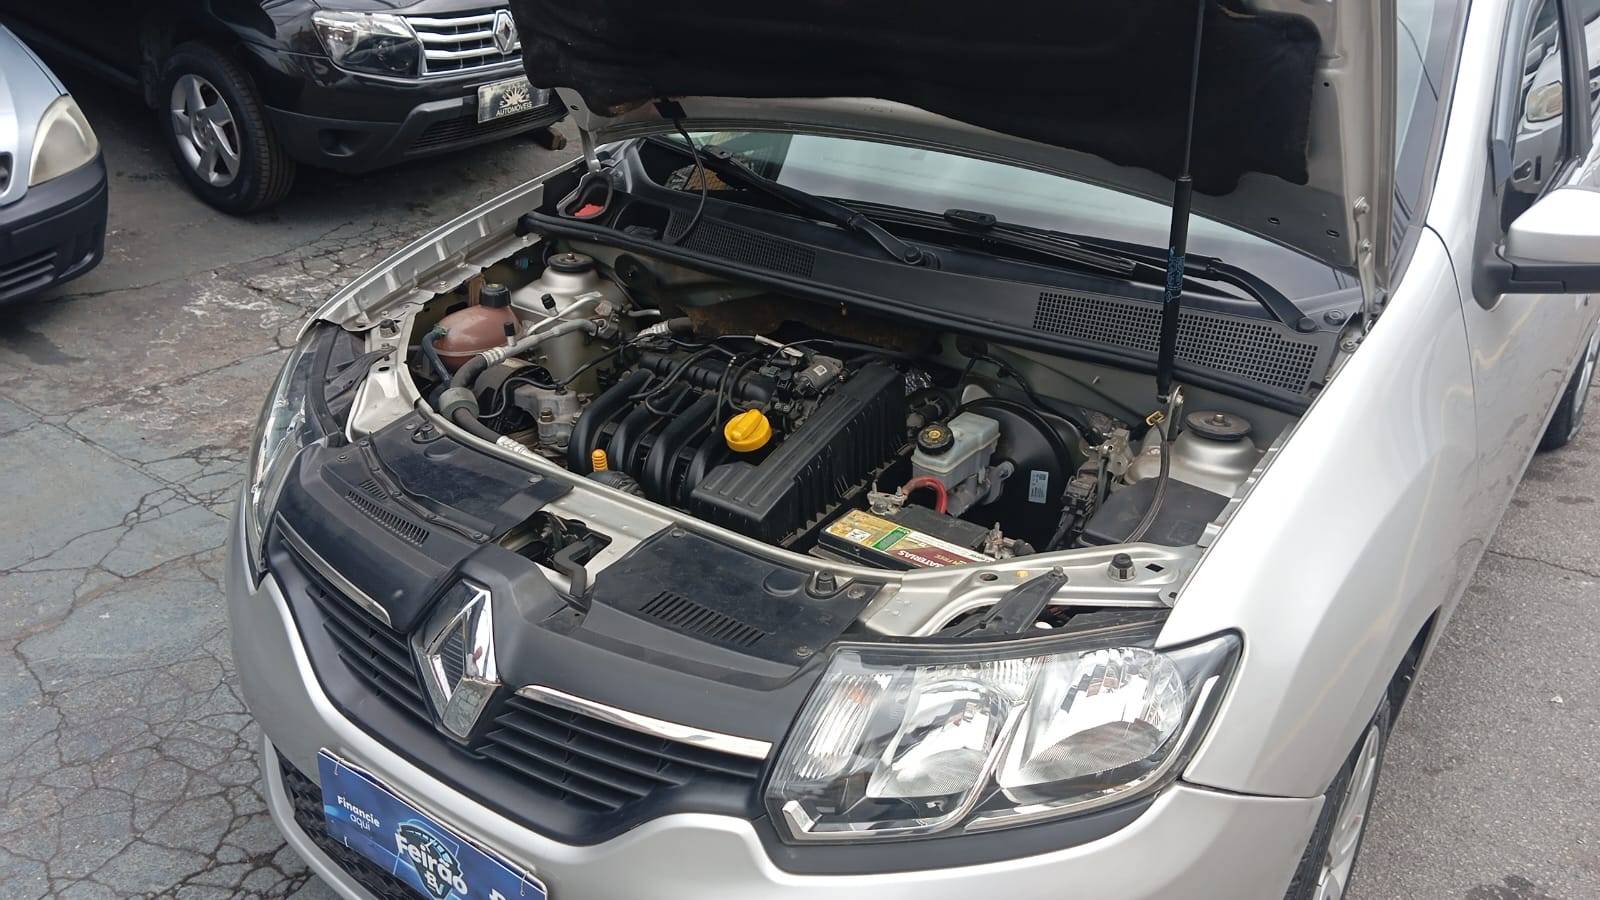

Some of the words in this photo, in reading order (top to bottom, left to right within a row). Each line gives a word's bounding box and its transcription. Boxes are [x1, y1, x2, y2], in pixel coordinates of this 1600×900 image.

[337, 794, 380, 828] Financie
[349, 813, 371, 832] aqui
[394, 832, 468, 895] Feirão
